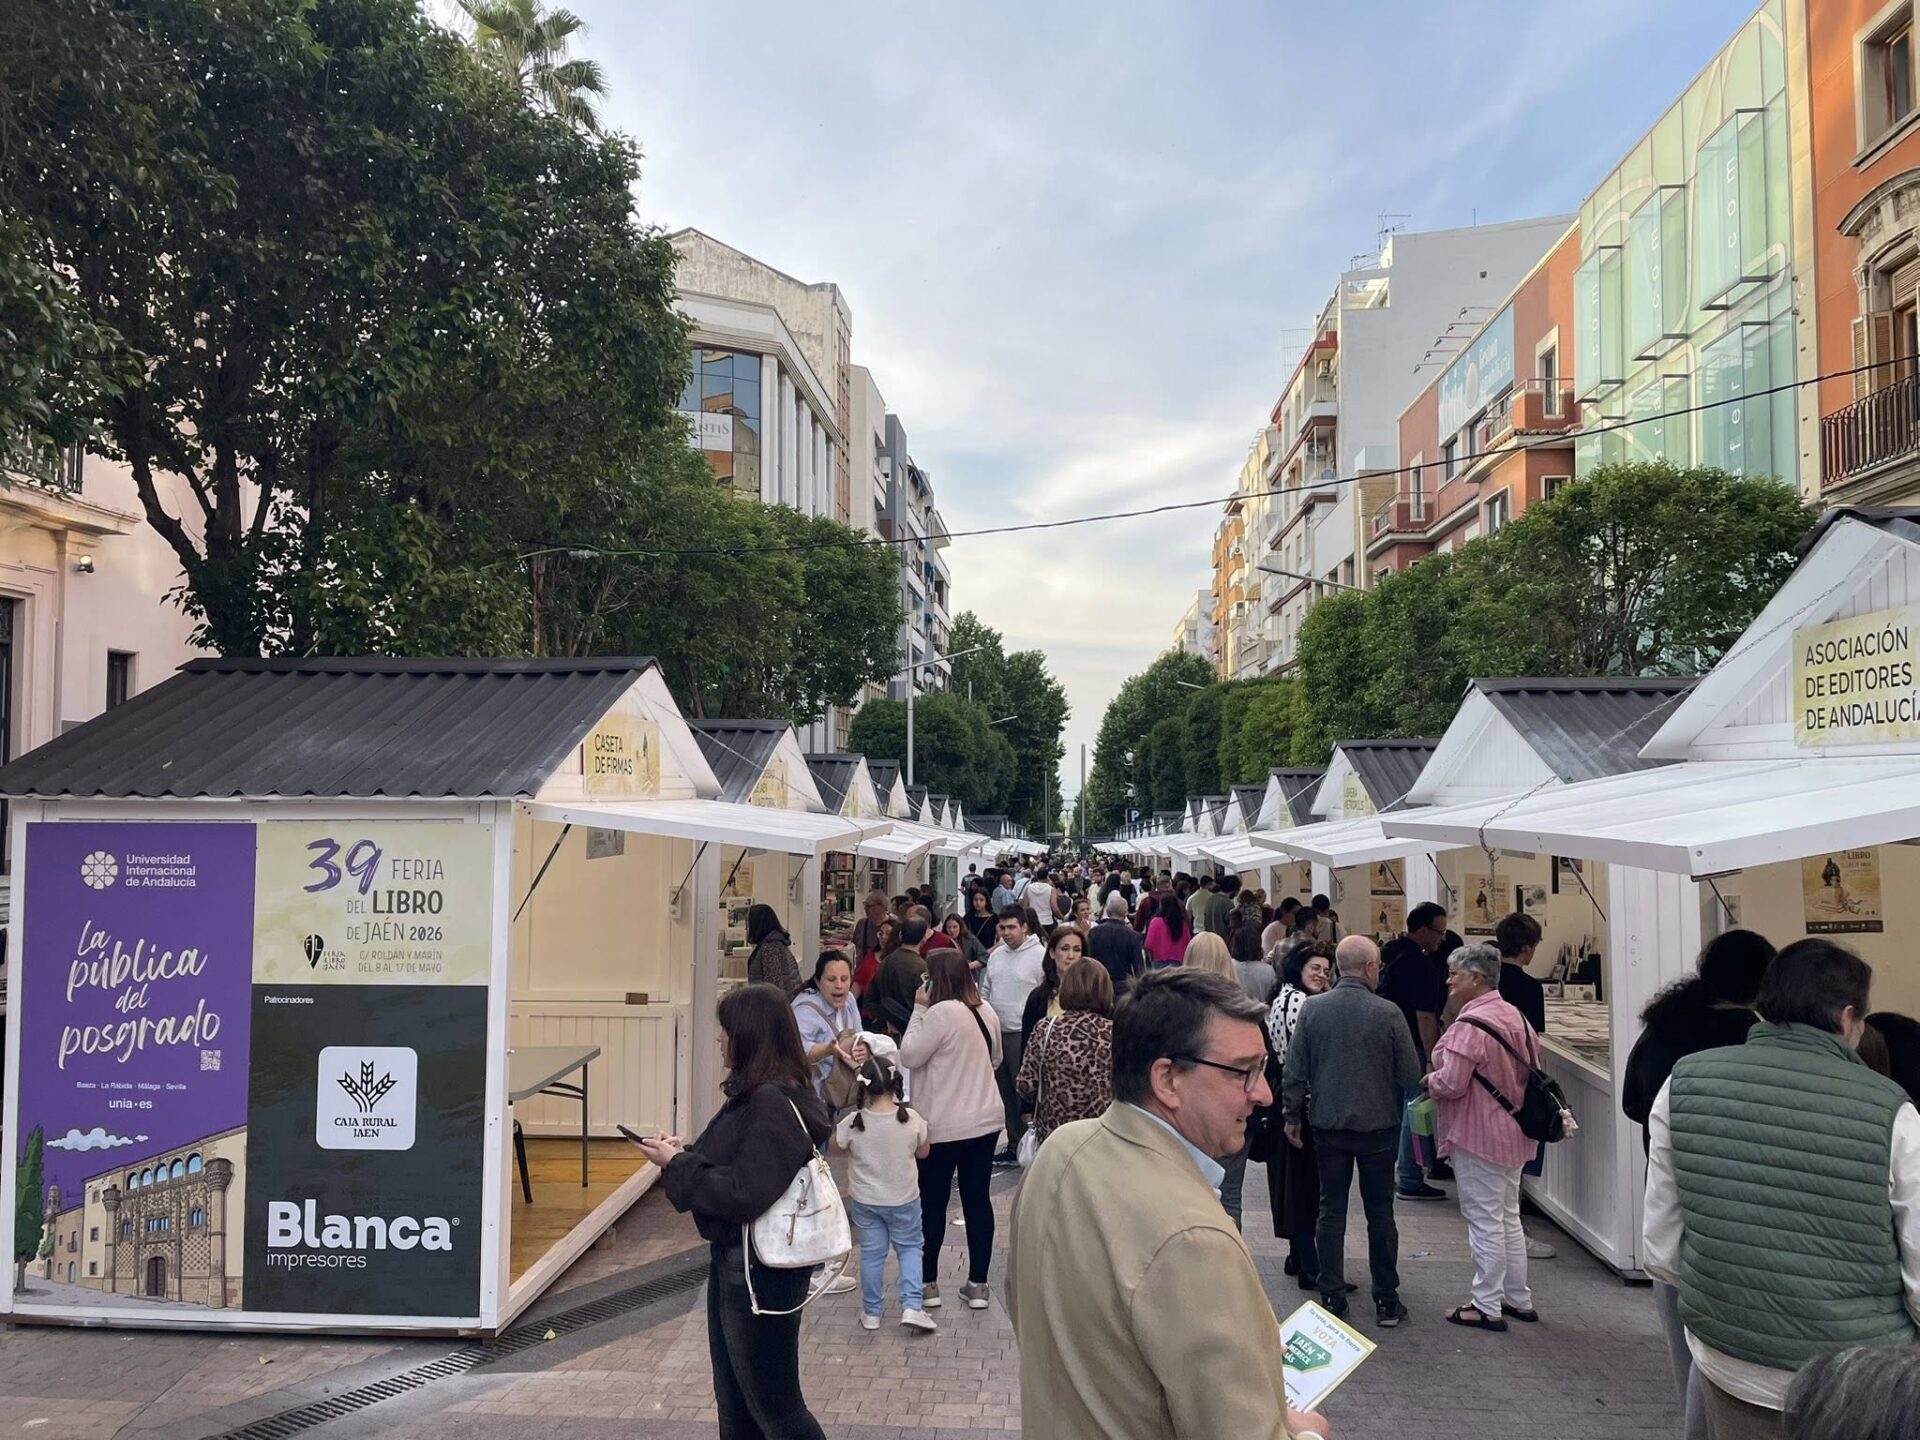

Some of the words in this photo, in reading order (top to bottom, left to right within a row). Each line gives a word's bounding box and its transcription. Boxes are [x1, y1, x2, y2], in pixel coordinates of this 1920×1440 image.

[698, 423, 729, 435] NTIS
[1805, 622, 1908, 667] ASOCIACIÓN
[1806, 676, 1825, 698] DE
[1829, 662, 1912, 695] EDITORES
[1806, 707, 1826, 730] DE
[594, 733, 624, 753] CASETA
[594, 756, 605, 774] DE
[607, 757, 633, 775] FIRMAS
[1131, 810, 1140, 822] P
[126, 854, 191, 865] Universidad
[126, 865, 196, 876] Internacional
[303, 837, 384, 895] 39
[391, 858, 444, 880] FERIA
[125, 877, 140, 887] de
[142, 877, 196, 887] Andalucía
[346, 900, 367, 914] DEL
[372, 889, 443, 915] LIBRO
[77, 919, 111, 956] La
[346, 926, 361, 941] DE
[362, 916, 405, 945] JAÉN
[409, 926, 443, 941] 2026
[359, 950, 370, 961] C/
[371, 948, 405, 960] ROLDÁN
[406, 951, 412, 960] Y
[413, 948, 442, 960] MARÍN
[66, 938, 208, 1003] pública
[358, 962, 374, 973] DEL
[375, 962, 381, 972] 8
[382, 962, 393, 973] AL
[396, 962, 404, 972] 17
[406, 962, 418, 973] DE
[419, 962, 442, 973] MAYO
[115, 983, 150, 1014] del
[264, 995, 314, 1005] Patrocinadores
[58, 998, 221, 1070] posgrado
[137, 1082, 161, 1091] Málaga
[165, 1083, 187, 1091] Sevilla
[334, 1117, 359, 1127] CAJA
[362, 1117, 398, 1127] RURAL
[353, 1128, 380, 1138] JAEN
[267, 1198, 453, 1251] Blanca
[266, 1250, 367, 1271] impresores
[1292, 1335, 1316, 1357] JAÉN
[1312, 1326, 1338, 1350] VOTA
[1287, 1343, 1312, 1366] MERECE
